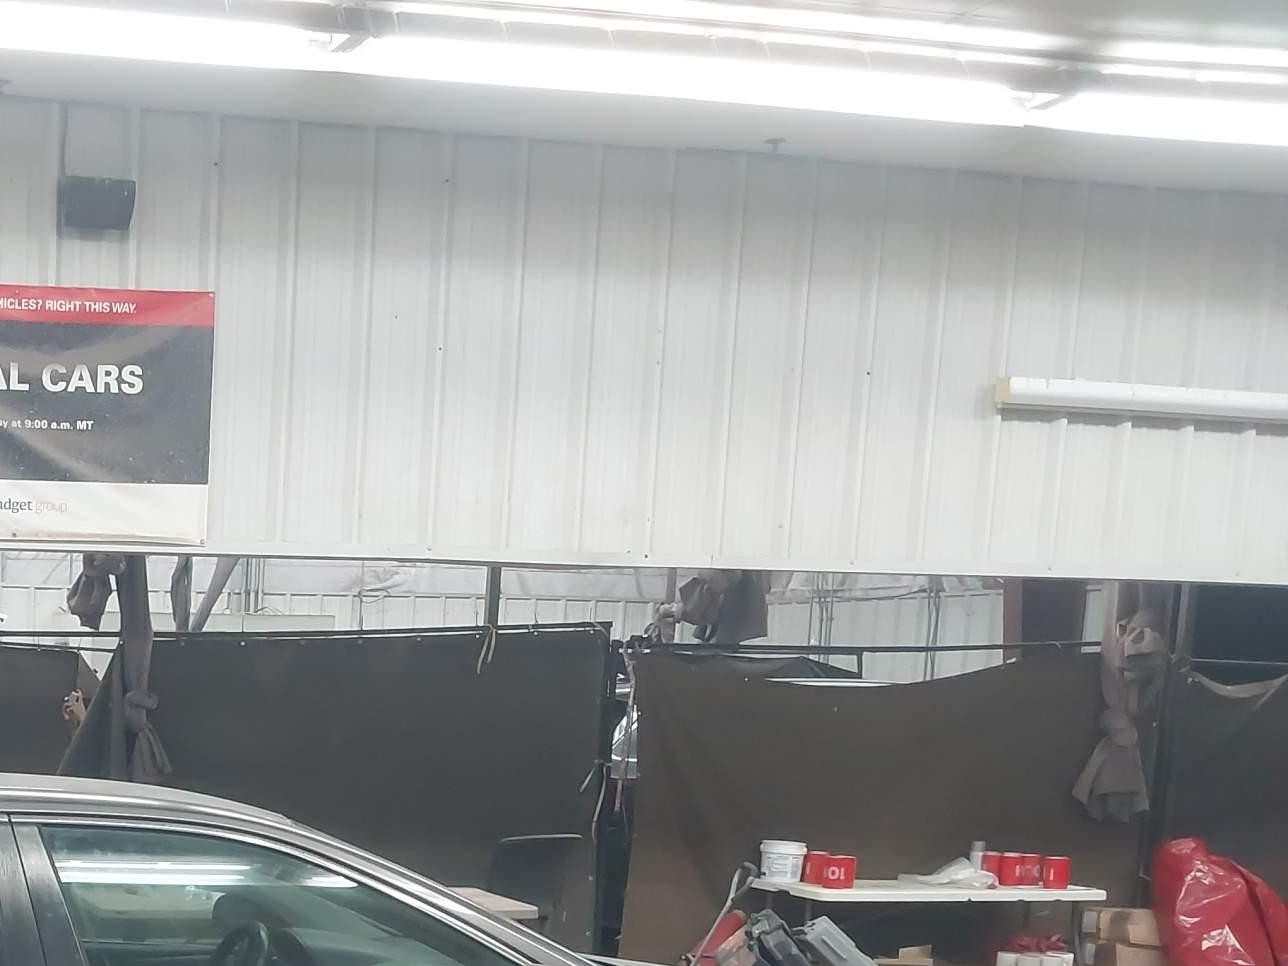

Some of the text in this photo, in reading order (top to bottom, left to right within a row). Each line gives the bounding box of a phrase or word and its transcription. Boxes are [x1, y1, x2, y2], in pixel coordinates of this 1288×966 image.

[45, 300, 82, 312] RIGHT
[84, 301, 111, 313] THIS
[111, 302, 137, 314] WAY.
[42, 364, 144, 395] CARS
[11, 419, 22, 428] at
[25, 420, 48, 429] 9:00
[51, 422, 73, 430] a.m.
[76, 420, 94, 431] MT
[35, 502, 68, 515] group
